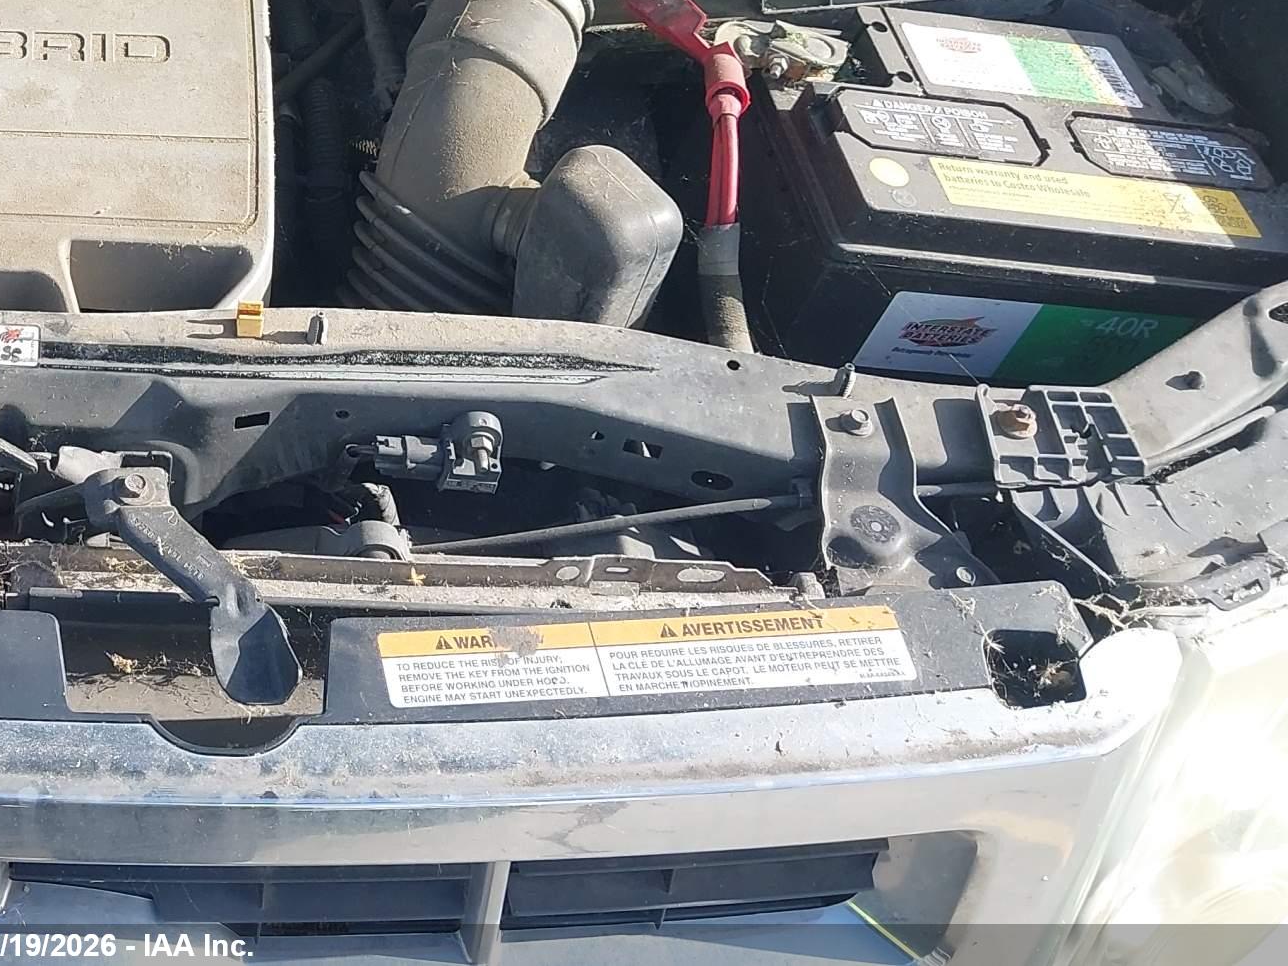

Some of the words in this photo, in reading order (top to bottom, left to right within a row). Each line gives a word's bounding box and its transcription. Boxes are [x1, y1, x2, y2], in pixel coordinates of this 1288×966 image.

[939, 162, 973, 174] Return
[975, 167, 1020, 181] warranty
[1023, 171, 1042, 181] and
[1044, 175, 1068, 185] used
[944, 174, 989, 186] batteries
[1002, 179, 1038, 191] Costco
[905, 321, 991, 337] INTERSTATE
[1096, 316, 1159, 339] 40R
[902, 331, 981, 344] BATTERIES
[681, 615, 823, 636] AVERTISSEMENT
[609, 650, 637, 659] POUR
[688, 646, 707, 655] LES
[709, 643, 754, 654] RISQUES
[756, 642, 770, 651] DE
[838, 636, 881, 646] RETIRER
[396, 662, 410, 671] TO
[413, 660, 455, 670] REDUCE
[458, 659, 477, 668] THE
[612, 662, 626, 670] LA
[650, 659, 664, 668] DE
[667, 656, 732, 667] L'ALLUMAGE
[734, 654, 766, 663] AVANT
[862, 647, 884, 656] DES
[398, 672, 442, 682] REMOVE
[444, 670, 465, 679] THE
[468, 669, 488, 678] KEY
[491, 667, 520, 677] FROM
[524, 666, 543, 675] THE
[545, 664, 589, 674] IGNITION
[616, 670, 662, 681] TRAVAUX
[664, 669, 693, 678] SOUS
[696, 668, 708, 677] LE
[752, 664, 766, 674] LE
[768, 662, 811, 673] MOTEUR
[843, 659, 857, 668] SE
[859, 656, 900, 667] METTRE
[400, 682, 443, 692] BEFORE
[445, 680, 495, 690] WORKING
[498, 678, 533, 687] UNDER
[619, 683, 632, 692] EN
[635, 681, 678, 691] MARCHE
[403, 693, 442, 704] ENGINE
[445, 693, 465, 701] MAY
[469, 690, 501, 700] START
[504, 686, 586, 698] UNEXPECTEDLY.
